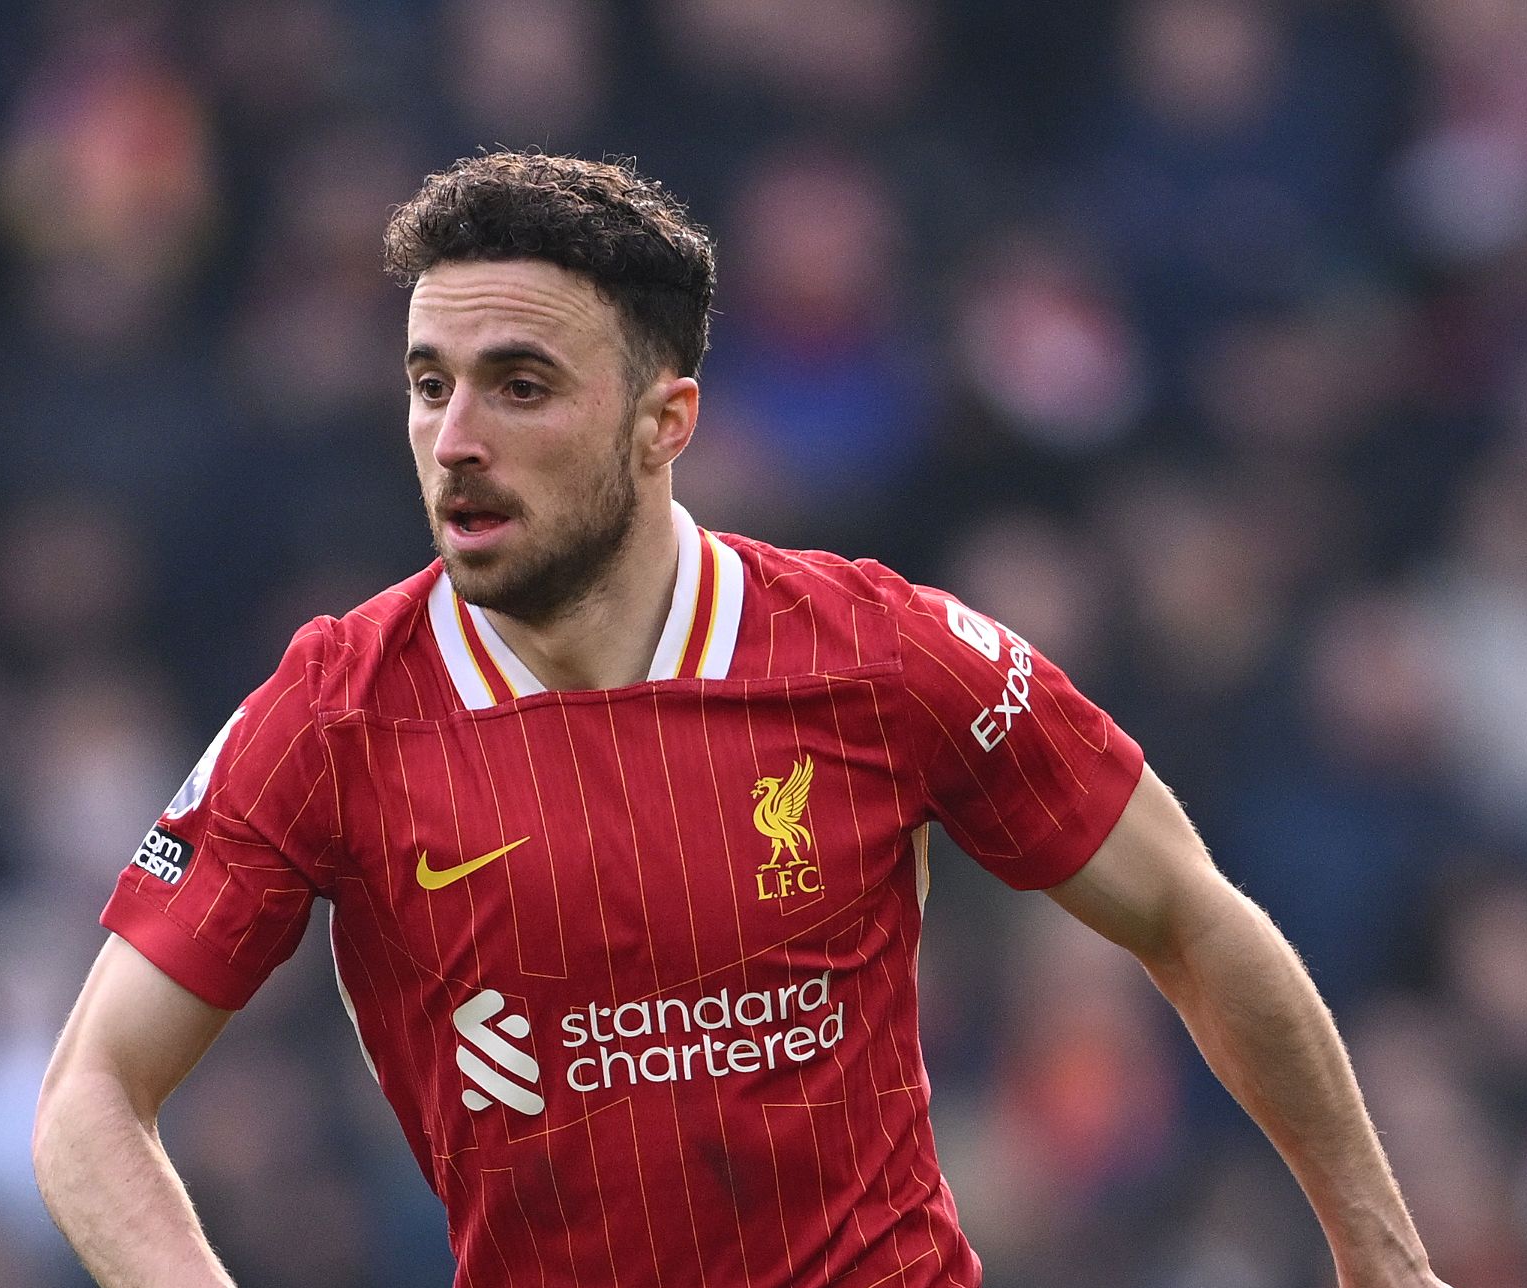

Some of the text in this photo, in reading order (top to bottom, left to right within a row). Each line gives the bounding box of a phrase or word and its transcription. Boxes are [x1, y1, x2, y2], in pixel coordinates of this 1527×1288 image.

[131, 848, 183, 885] cism
[561, 969, 832, 1048] standard
[566, 1001, 845, 1093] chartered
